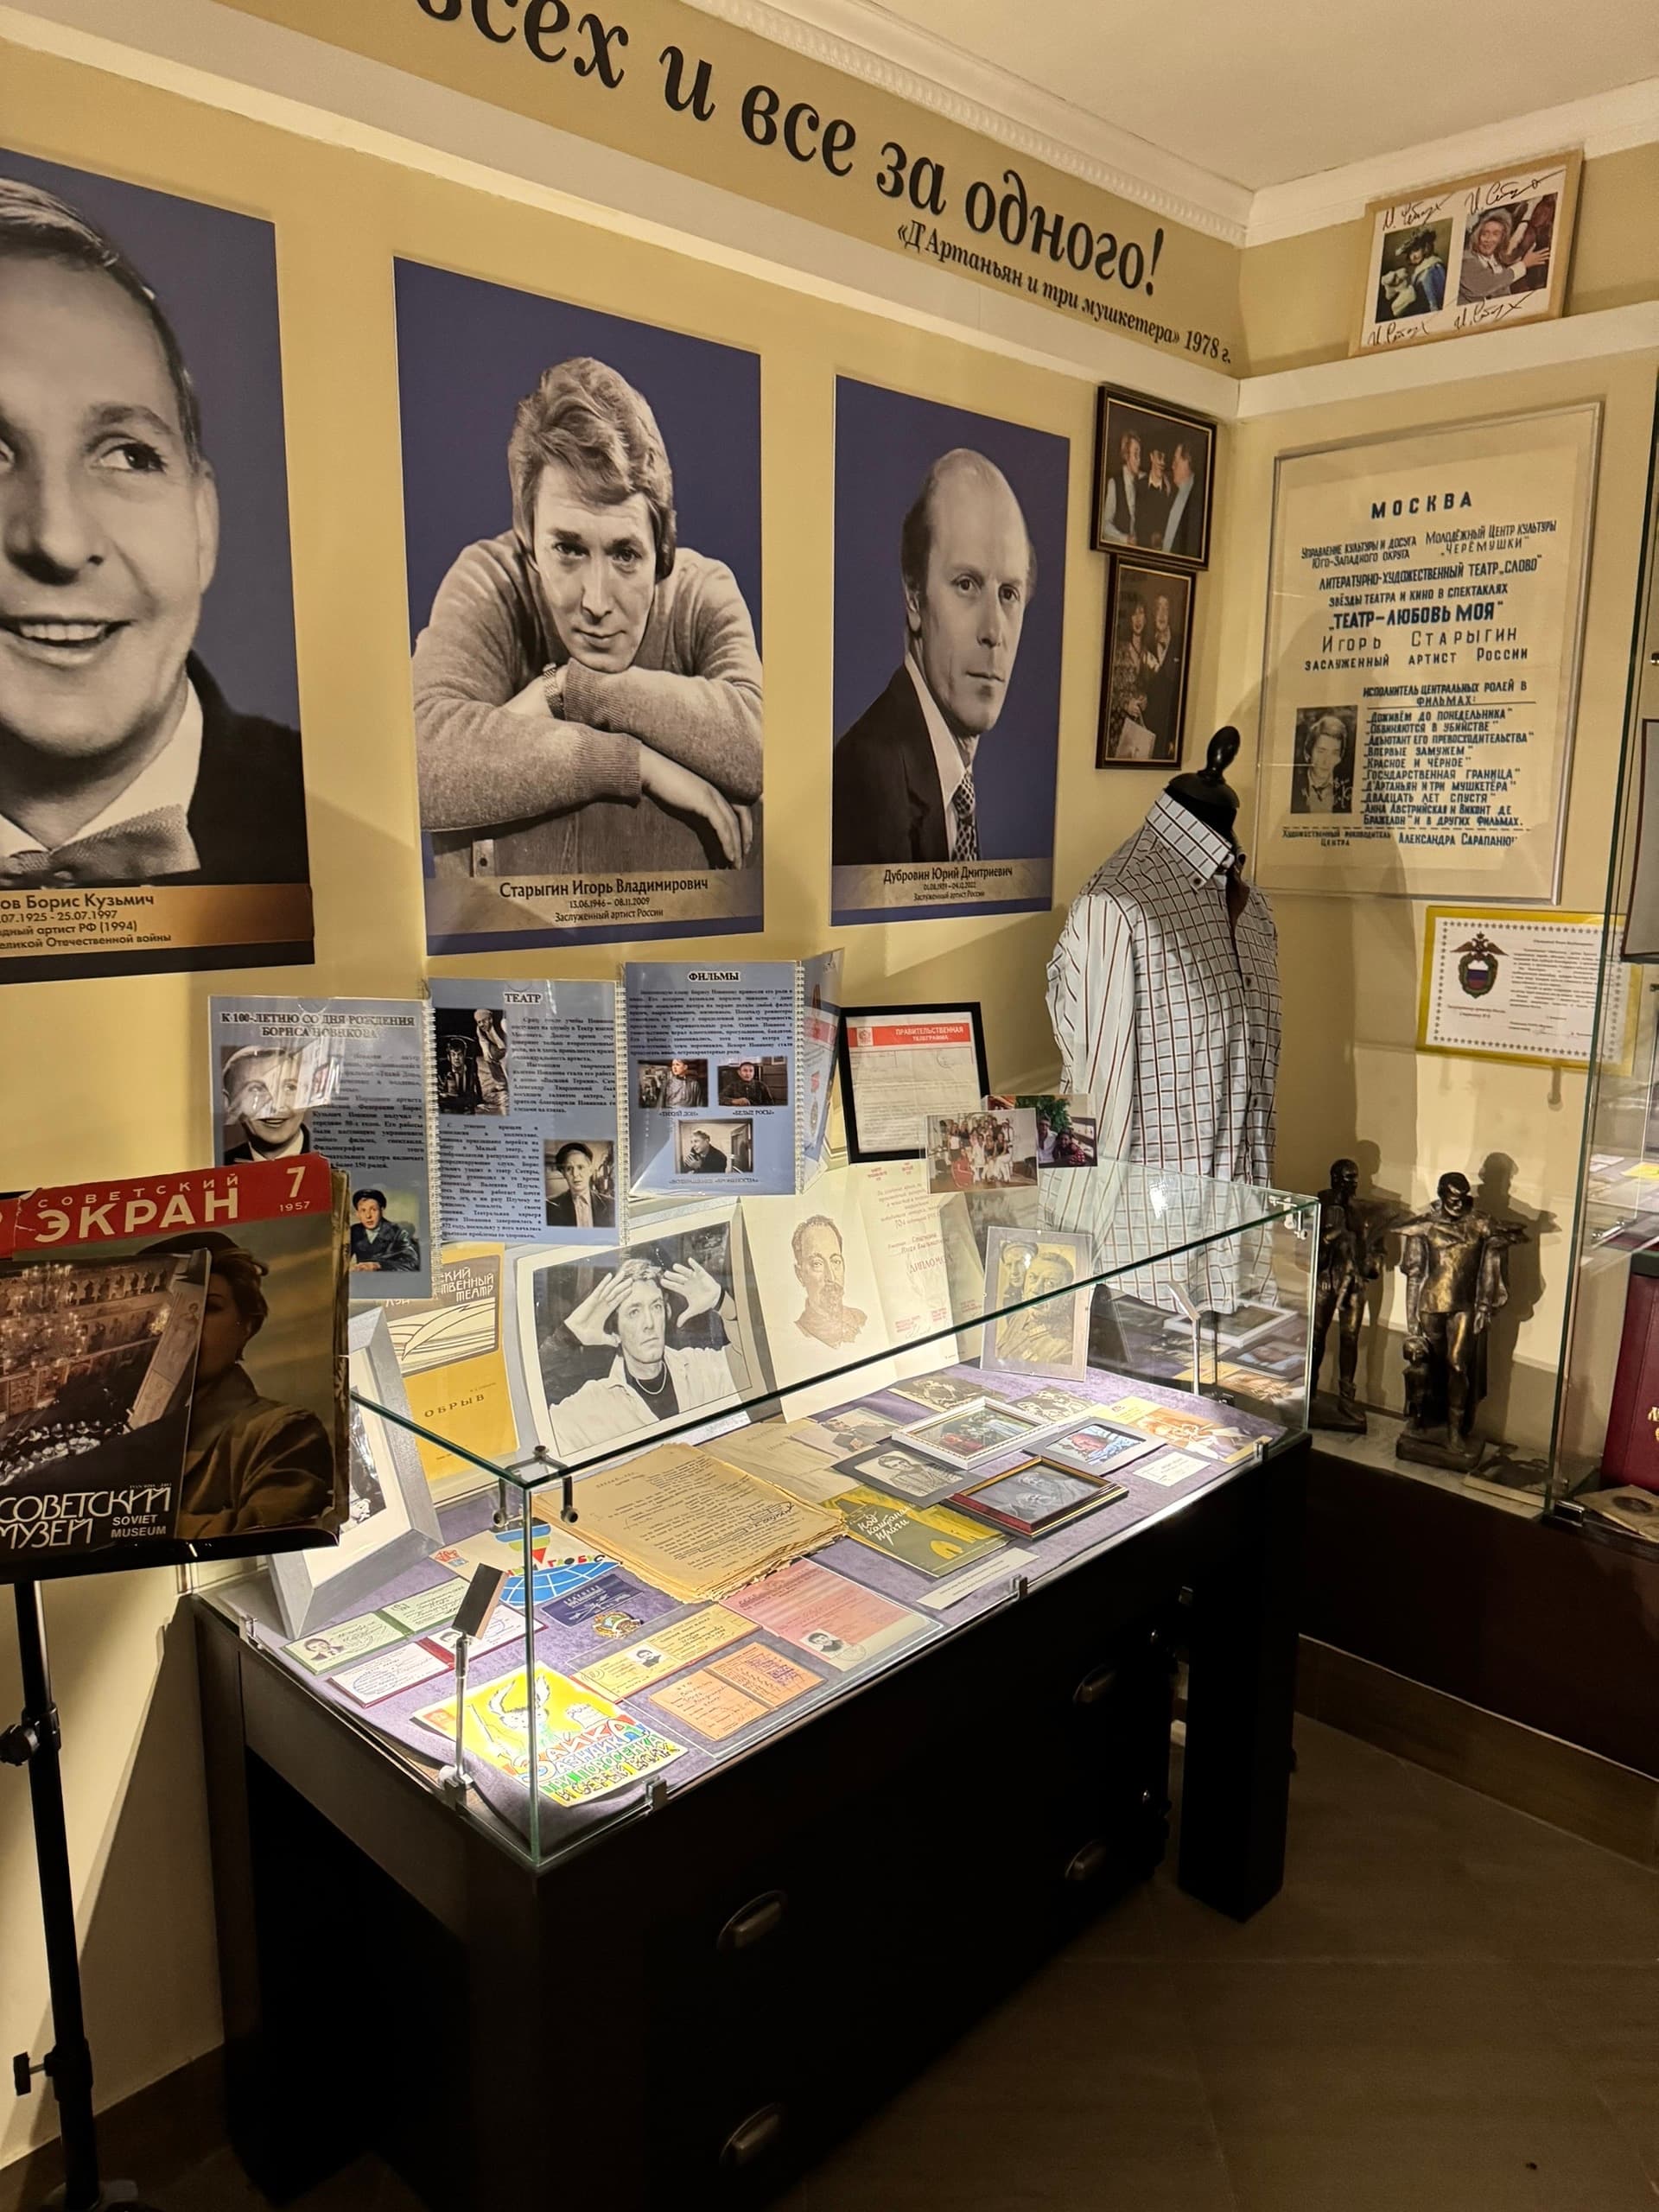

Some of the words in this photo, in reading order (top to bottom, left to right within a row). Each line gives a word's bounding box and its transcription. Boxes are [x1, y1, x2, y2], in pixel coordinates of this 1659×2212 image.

[659, 46, 715, 121] и
[741, 85, 856, 176] все
[876, 142, 946, 215] за
[965, 169, 1164, 296] одного!
[1027, 273, 1039, 295] и
[1042, 281, 1086, 311] три
[1082, 297, 1180, 345] мушкетера»
[1185, 329, 1219, 360] 1978
[1222, 347, 1231, 364] г.
[1371, 492, 1471, 518] МОСКВА
[1517, 520, 1557, 536] КУЛЬТУРЫ
[1301, 544, 1342, 559] УПРАВЛЕНИЕ
[1344, 540, 1379, 554] КУЛЬТУРЫ
[1380, 539, 1385, 549] И
[1389, 536, 1416, 549] ДОСУГА
[1382, 549, 1410, 562] ОКРУГА
[1319, 562, 1464, 590] ЛИТЕРАТУРНО-ХУДОЖЕСТВЕННЫЙ
[1469, 562, 1498, 576] ТЕАТР
[1364, 593, 1395, 605] ТЕАТРА
[1400, 591, 1406, 601] И
[1409, 589, 1433, 601] КИНО
[1438, 588, 1444, 599] В
[1447, 583, 1509, 598] СПЕКТАКЛЯХ
[1305, 654, 1389, 671] ЗАСЛУЖЕННЫЙ
[1408, 652, 1458, 665] АРТИСТ
[1363, 685, 1419, 698] ИСПОЛНИТЕЛЬ
[1421, 683, 1479, 696] ЦЕНТРАЛЬНЫХ
[1484, 678, 1515, 692] РОЛЕЙ
[1521, 682, 1527, 691] В
[1417, 696, 1476, 707] ФИЛЬМАХ:
[1418, 712, 1431, 721] ДО
[1432, 723, 1437, 732] В
[1414, 735, 1428, 744] ЕГО
[1414, 759, 1420, 767] И
[1421, 782, 1427, 791] И
[1430, 782, 1445, 791] ТРИ
[1422, 793, 1440, 803] ЛЕТ
[1390, 803, 1447, 814] АВСТРИЙСКАЯ
[1451, 805, 1456, 814] И
[1459, 804, 1491, 815] ВИКОНТ
[1497, 805, 1511, 816] ДЕ
[1414, 816, 1420, 824] И
[1427, 817, 1431, 825] В
[1436, 816, 1470, 826] ДРУГИХ
[1398, 832, 1456, 846] АЛЕКСАНДРА
[883, 869, 930, 885] Дубровин
[931, 867, 959, 881] Юрий
[961, 866, 1013, 880] Дмитриевич
[499, 882, 569, 900] Старыгин
[572, 880, 613, 898] Игорь
[617, 879, 709, 894] Владимирович
[26, 895, 79, 912] Борис
[85, 893, 154, 910] Кузьмич
[57, 910, 118, 921] 25.07.1997
[555, 912, 609, 923] Заслуженный
[611, 911, 635, 920] артист
[637, 908, 664, 918] России
[36, 925, 75, 937] артист
[79, 922, 97, 933] РФ
[99, 920, 137, 933] (1994)
[46, 935, 133, 947] Отечественной
[137, 933, 172, 943] войны
[689, 972, 739, 982] ФИЛЬМЫ
[505, 994, 541, 1003] ТЕАТР
[221, 1013, 230, 1022] К
[302, 1014, 319, 1023] СО
[322, 1015, 346, 1025] ДНЯ
[348, 1015, 416, 1027] РОЖДЕНИЯ
[262, 1027, 309, 1037] БОРИСА
[895, 1026, 964, 1036] ПРАВИТЕЛЬСТВЕННАЯ
[37, 1173, 239, 1209] СОВЕТСКИЙ
[286, 1166, 306, 1198] 7
[34, 1188, 238, 1243] ЭКРАН
[279, 1201, 310, 1213] 1957
[456, 1285, 493, 1302] ТЕАТР
[424, 1394, 485, 1418] ОБРЫВ
[0, 1487, 171, 1523] СОВЕТСКИЙ
[112, 1514, 158, 1526] SOVIET
[111, 1526, 166, 1538] MUSEUM
